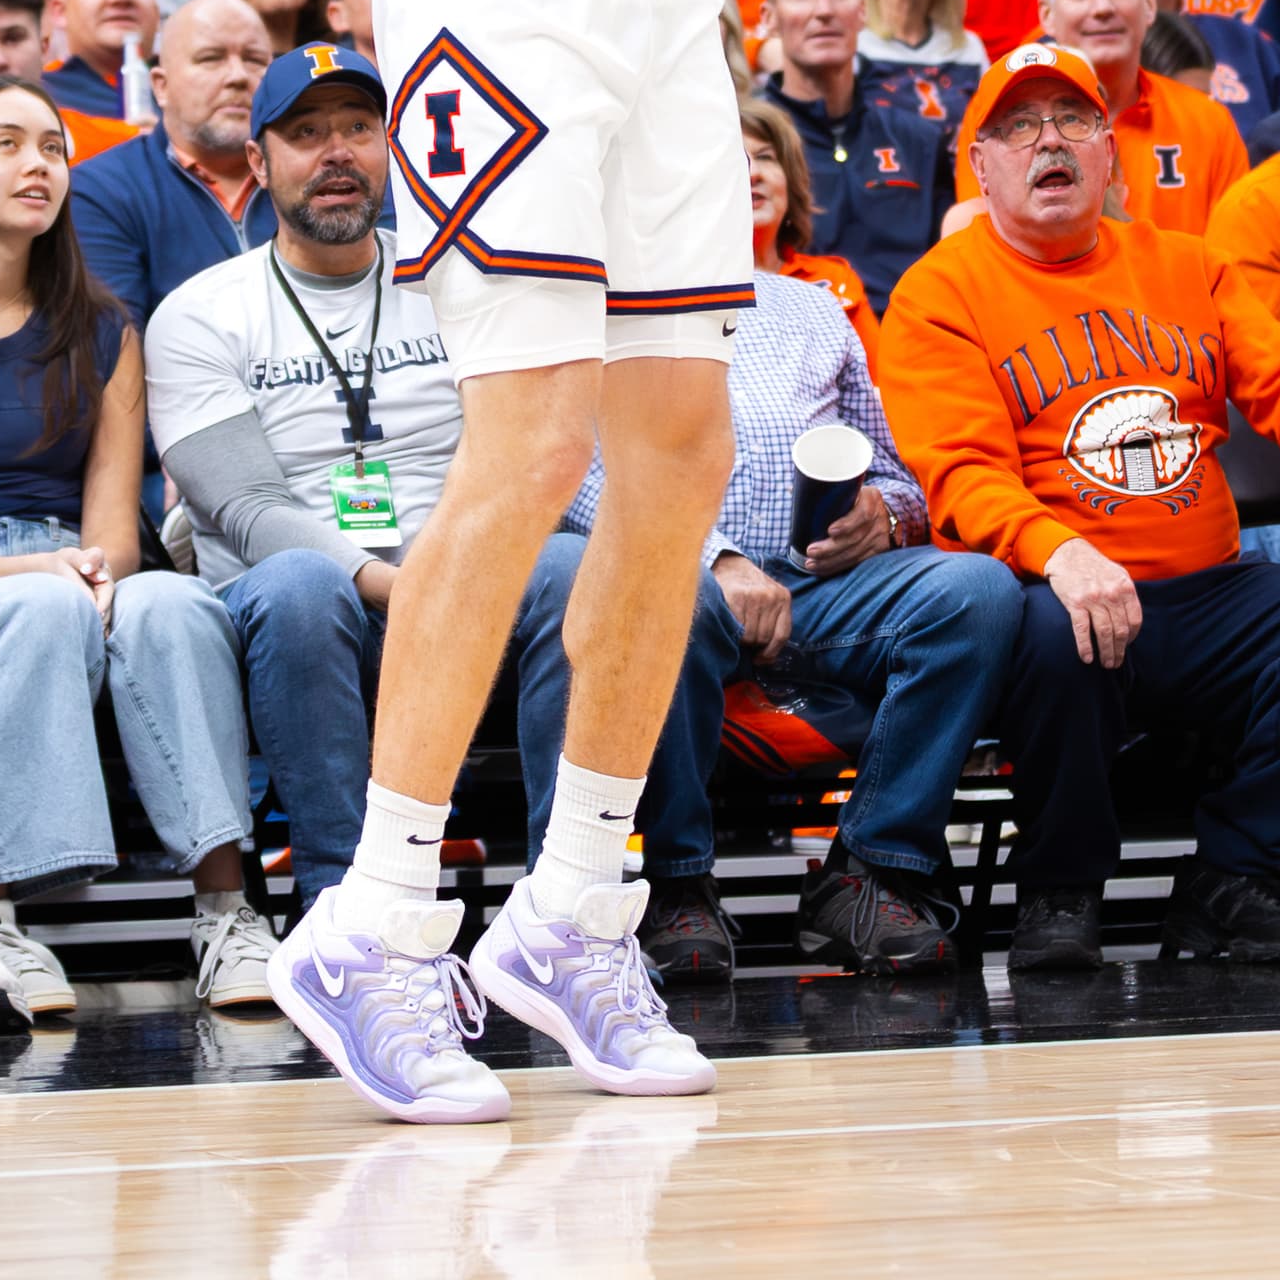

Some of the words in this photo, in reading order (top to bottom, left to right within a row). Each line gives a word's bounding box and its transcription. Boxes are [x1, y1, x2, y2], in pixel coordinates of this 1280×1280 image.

[304, 45, 343, 79] I
[914, 77, 947, 120] I
[425, 89, 466, 178] I
[873, 148, 900, 173] I
[1153, 144, 1186, 189] I
[371, 333, 449, 374] ILLIN
[999, 308, 1221, 427] ILLINOIS
